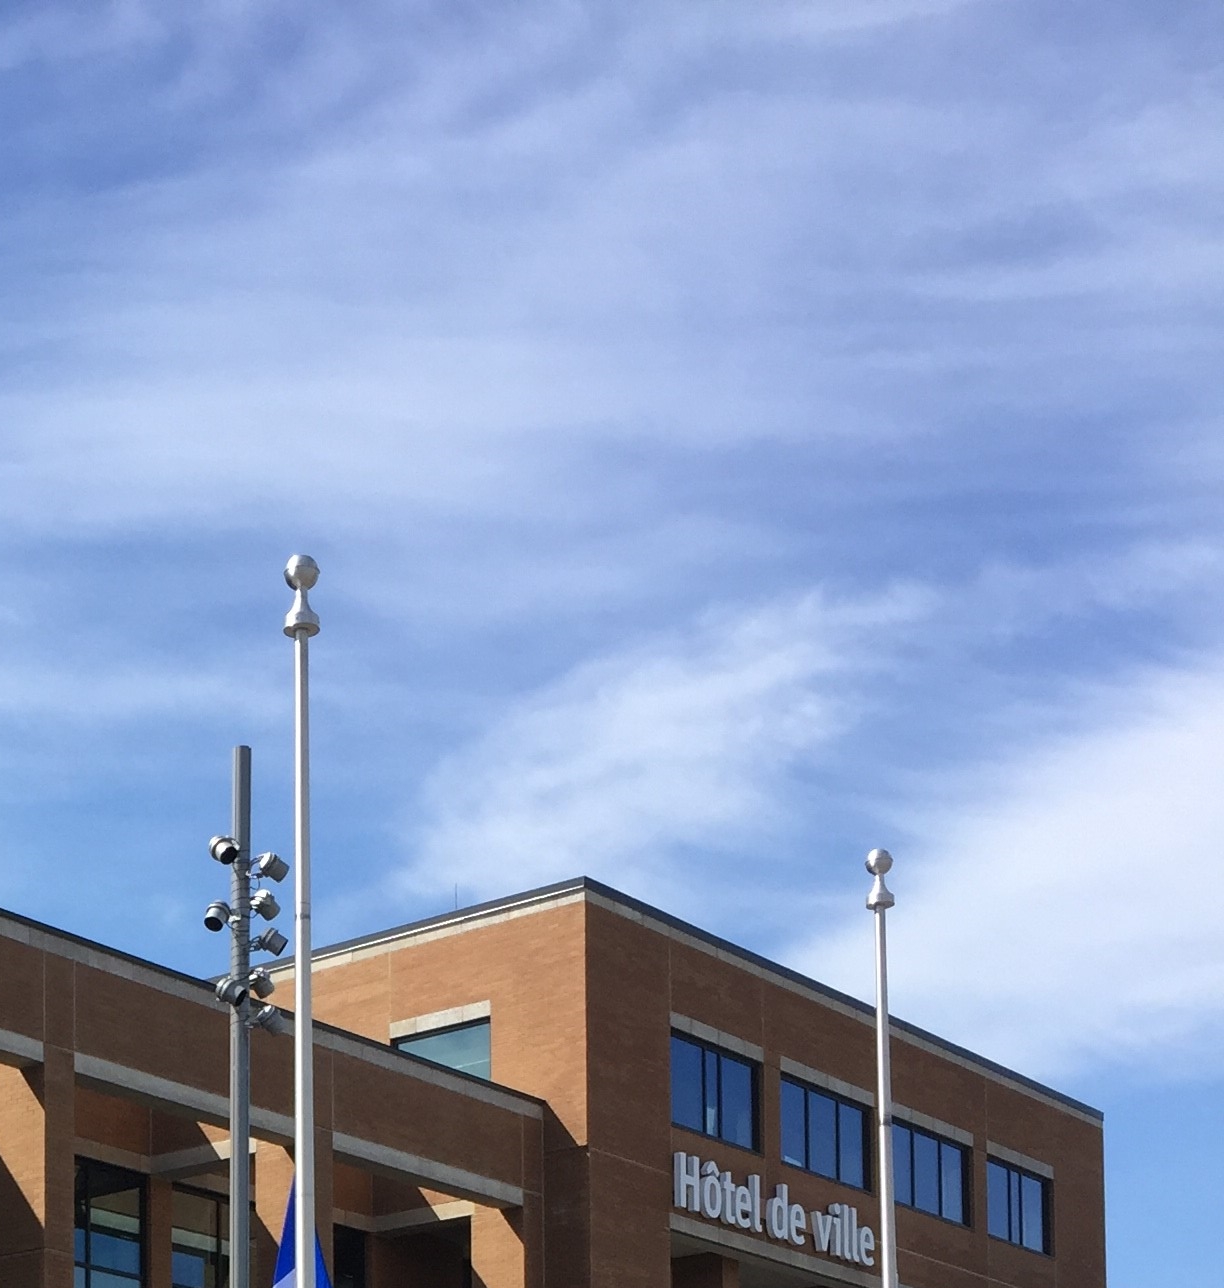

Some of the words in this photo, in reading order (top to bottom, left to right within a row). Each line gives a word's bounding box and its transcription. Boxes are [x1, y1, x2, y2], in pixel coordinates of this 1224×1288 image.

[674, 1151, 763, 1232] Hôtel
[766, 1183, 806, 1246] de
[810, 1202, 875, 1266] ville
